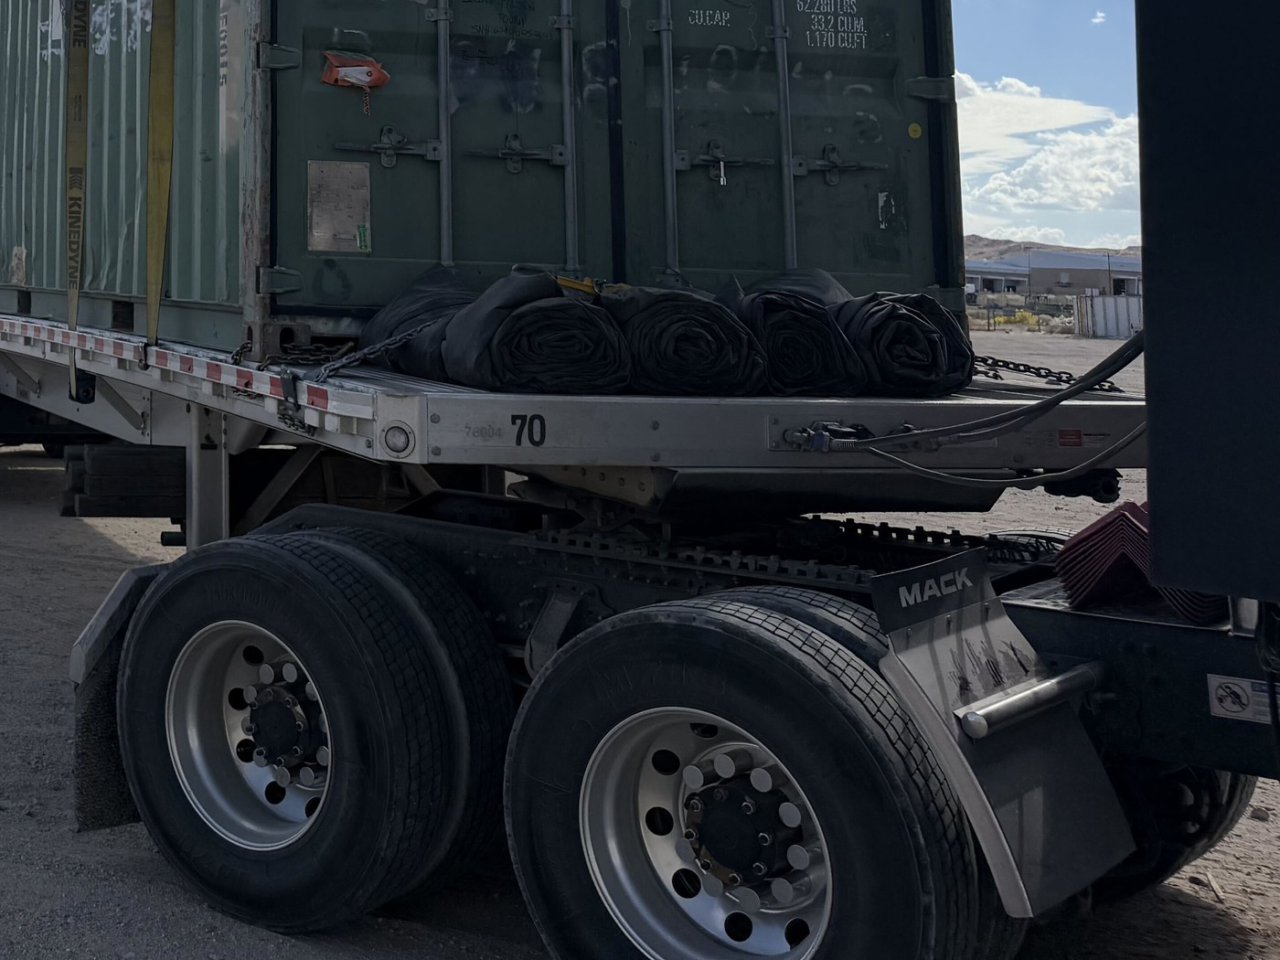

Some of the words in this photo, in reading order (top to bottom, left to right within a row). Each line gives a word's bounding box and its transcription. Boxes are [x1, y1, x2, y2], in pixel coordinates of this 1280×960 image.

[836, 0, 857, 14] LBS
[811, 15, 834, 31] 33.2
[805, 31, 835, 48] 1.170
[68, 197, 84, 290] KINEDYNE
[511, 414, 547, 447] 70
[898, 567, 974, 608] MACK
